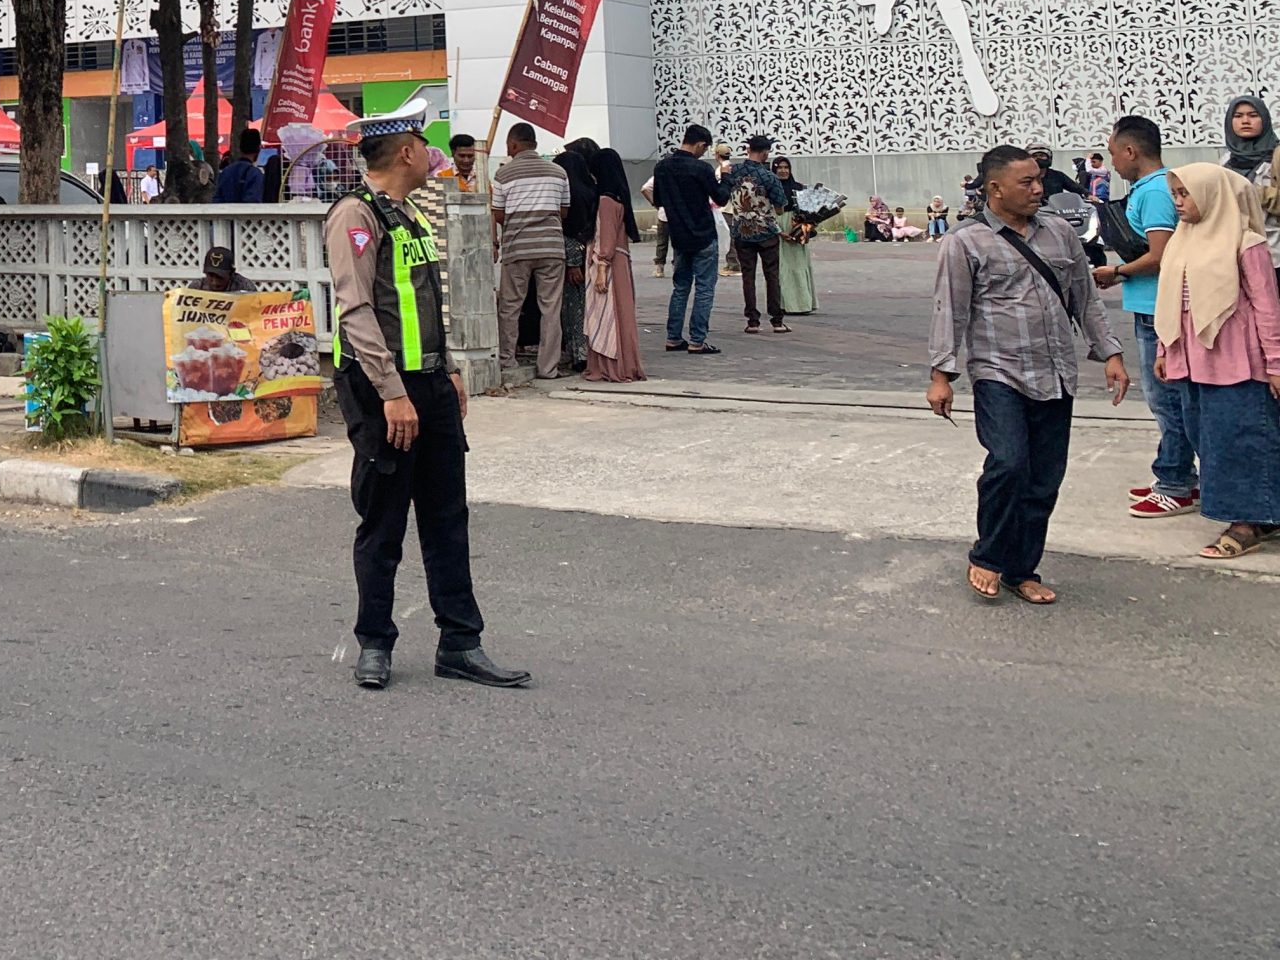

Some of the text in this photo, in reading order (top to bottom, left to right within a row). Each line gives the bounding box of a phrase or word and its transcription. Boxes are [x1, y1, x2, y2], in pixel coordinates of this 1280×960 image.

[533, 56, 569, 80] Cabang
[278, 99, 305, 112] Cabang
[176, 294, 235, 312] ICE TEA
[261, 300, 305, 316] ANEKA
[263, 315, 311, 330] PENTOL
